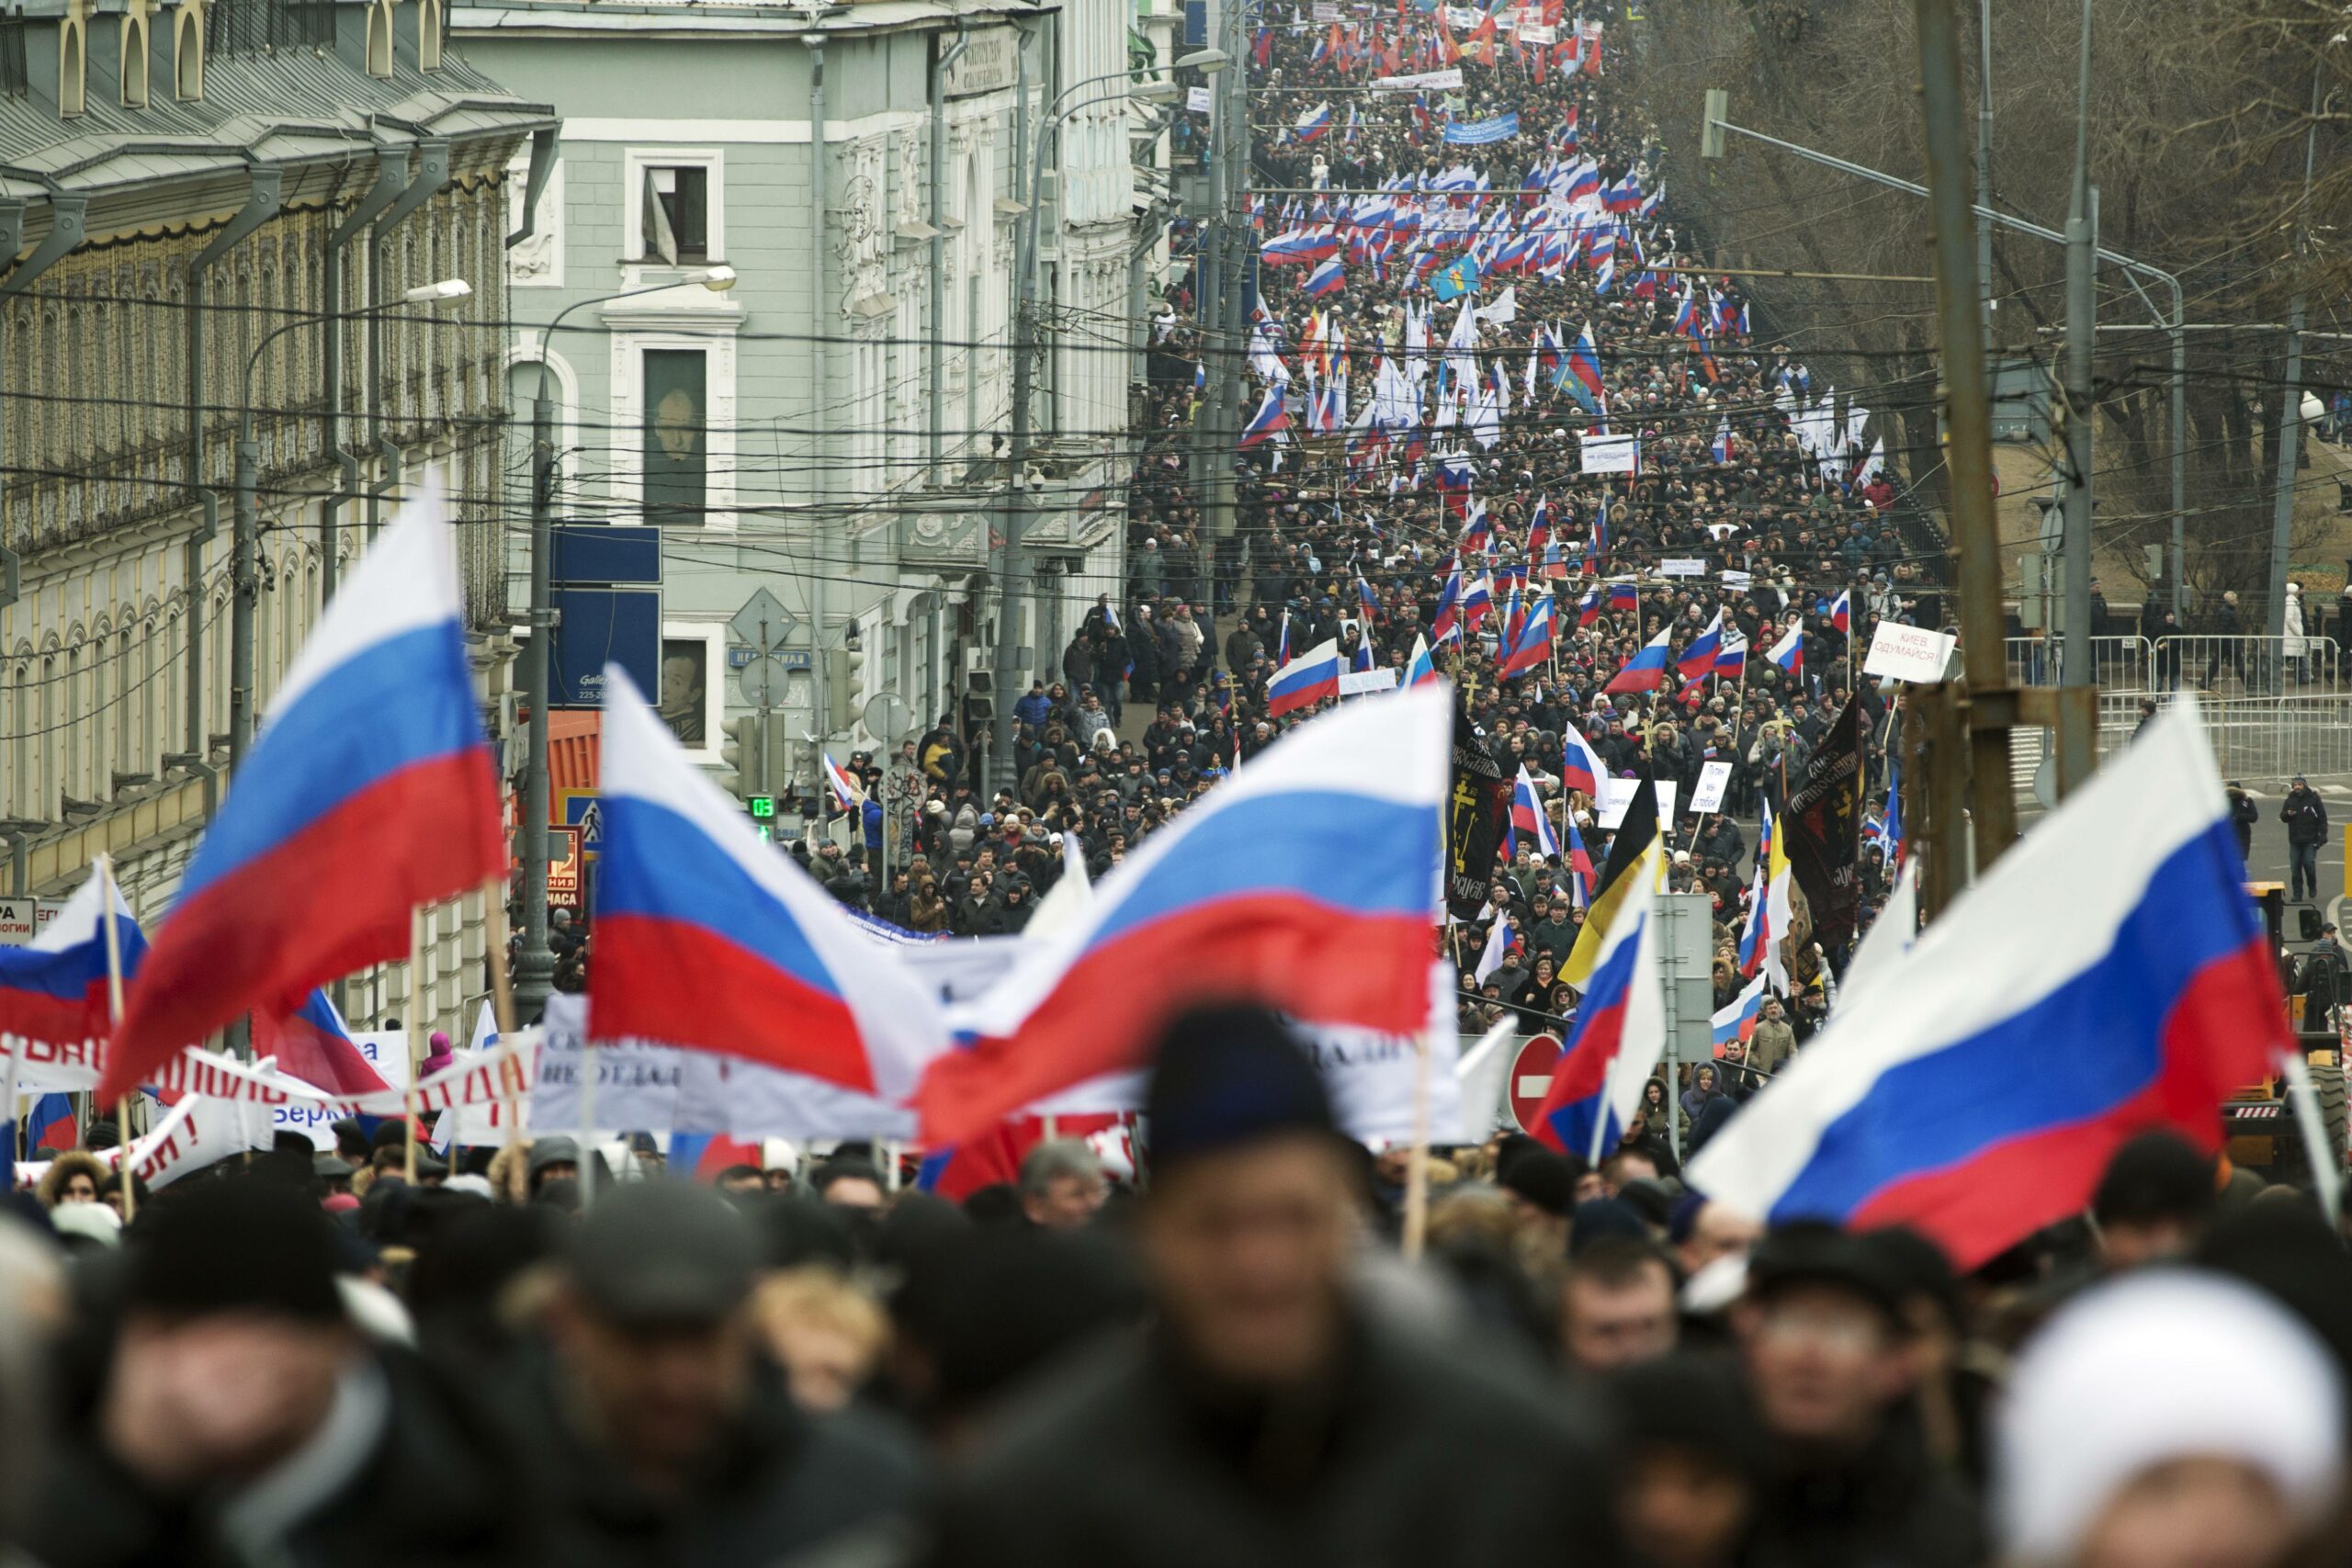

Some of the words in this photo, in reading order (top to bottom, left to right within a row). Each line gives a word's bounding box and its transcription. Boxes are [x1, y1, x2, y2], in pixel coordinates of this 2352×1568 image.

[737, 651, 806, 664] НЕНАЯ
[1875, 641, 1939, 661] ОДУМАЙСЯ!
[548, 878, 574, 887] НИЯ
[547, 893, 577, 906] ЧАСА
[0, 923, 30, 934] ОГИИ
